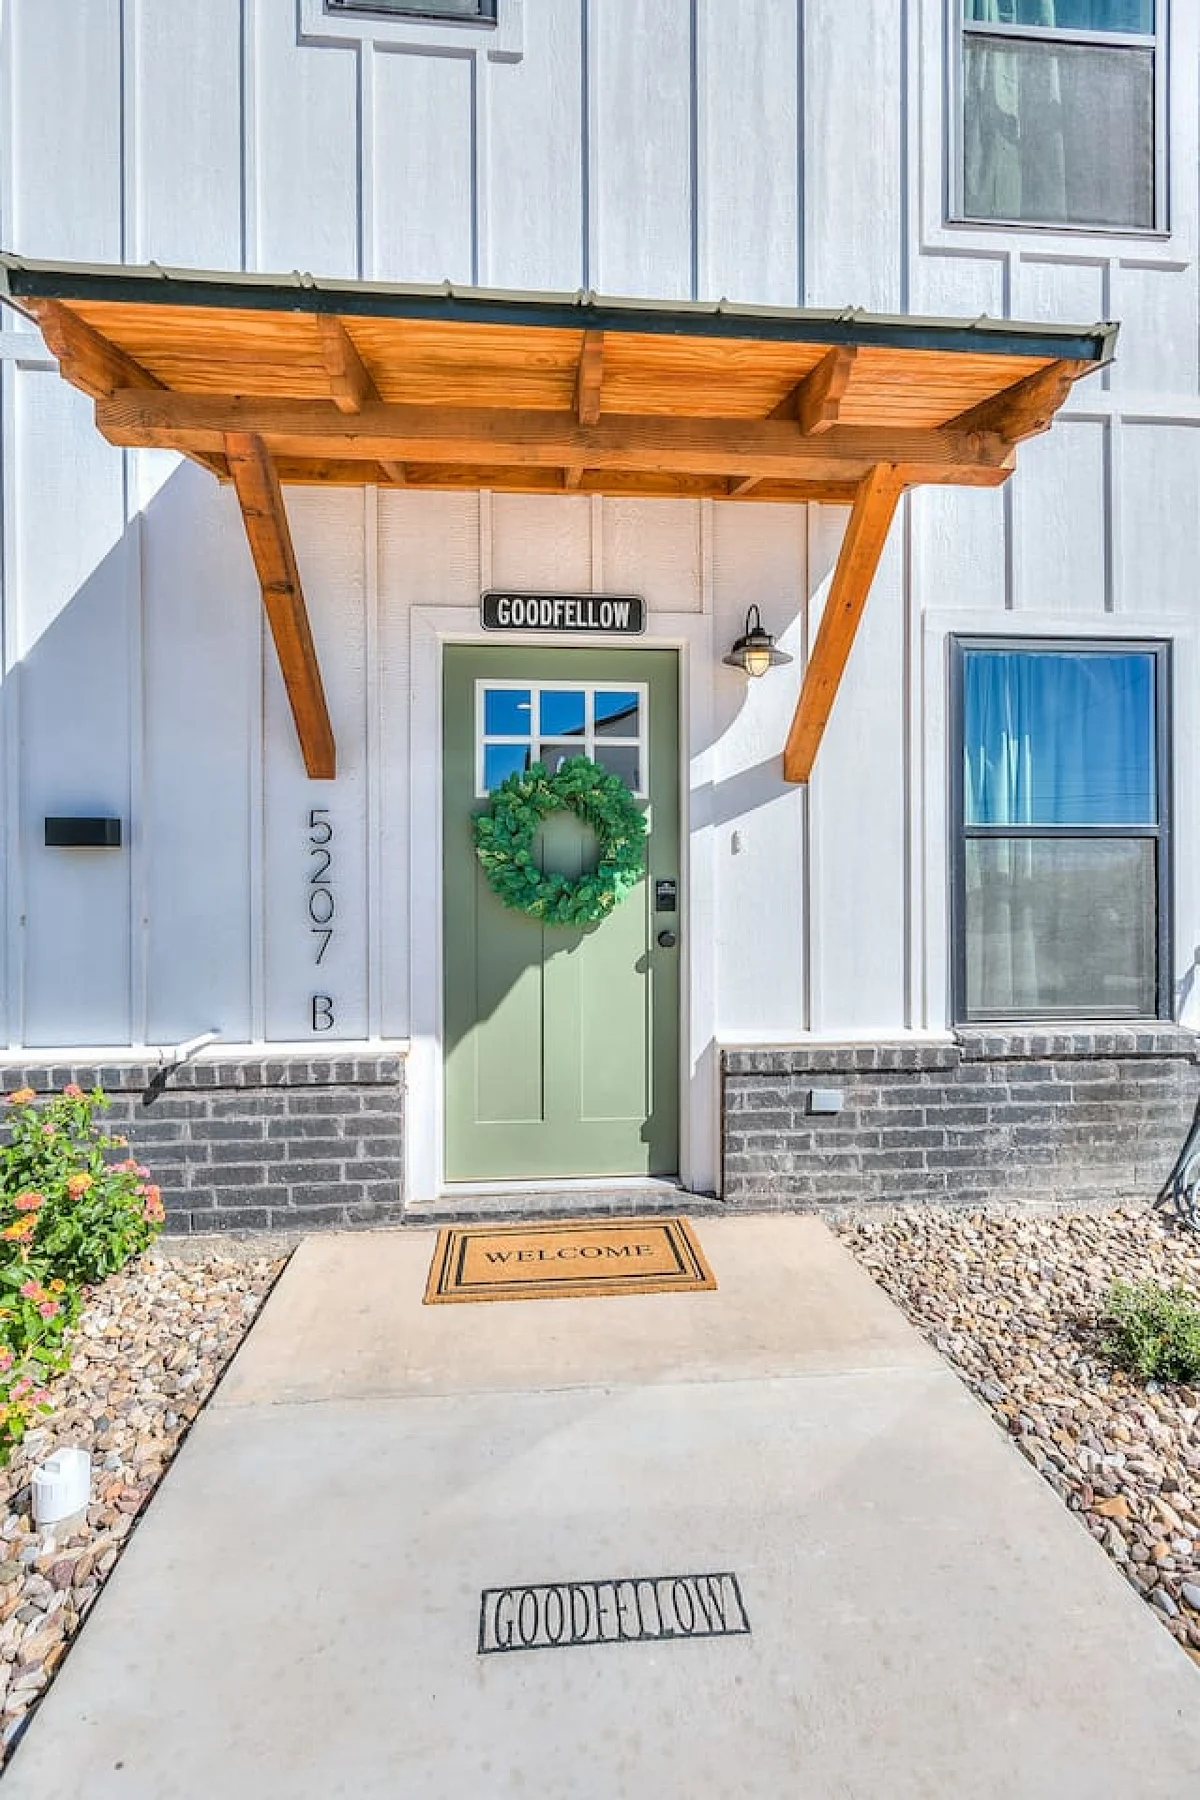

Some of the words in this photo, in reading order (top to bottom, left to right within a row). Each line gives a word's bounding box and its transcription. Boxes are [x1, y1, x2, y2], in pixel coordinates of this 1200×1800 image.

[498, 597, 631, 629] GOODFELLOW
[308, 808, 335, 966] 5207
[311, 994, 335, 1032] B
[484, 1243, 654, 1264] WELCOME
[494, 1574, 730, 1649] GOODFELLOW
